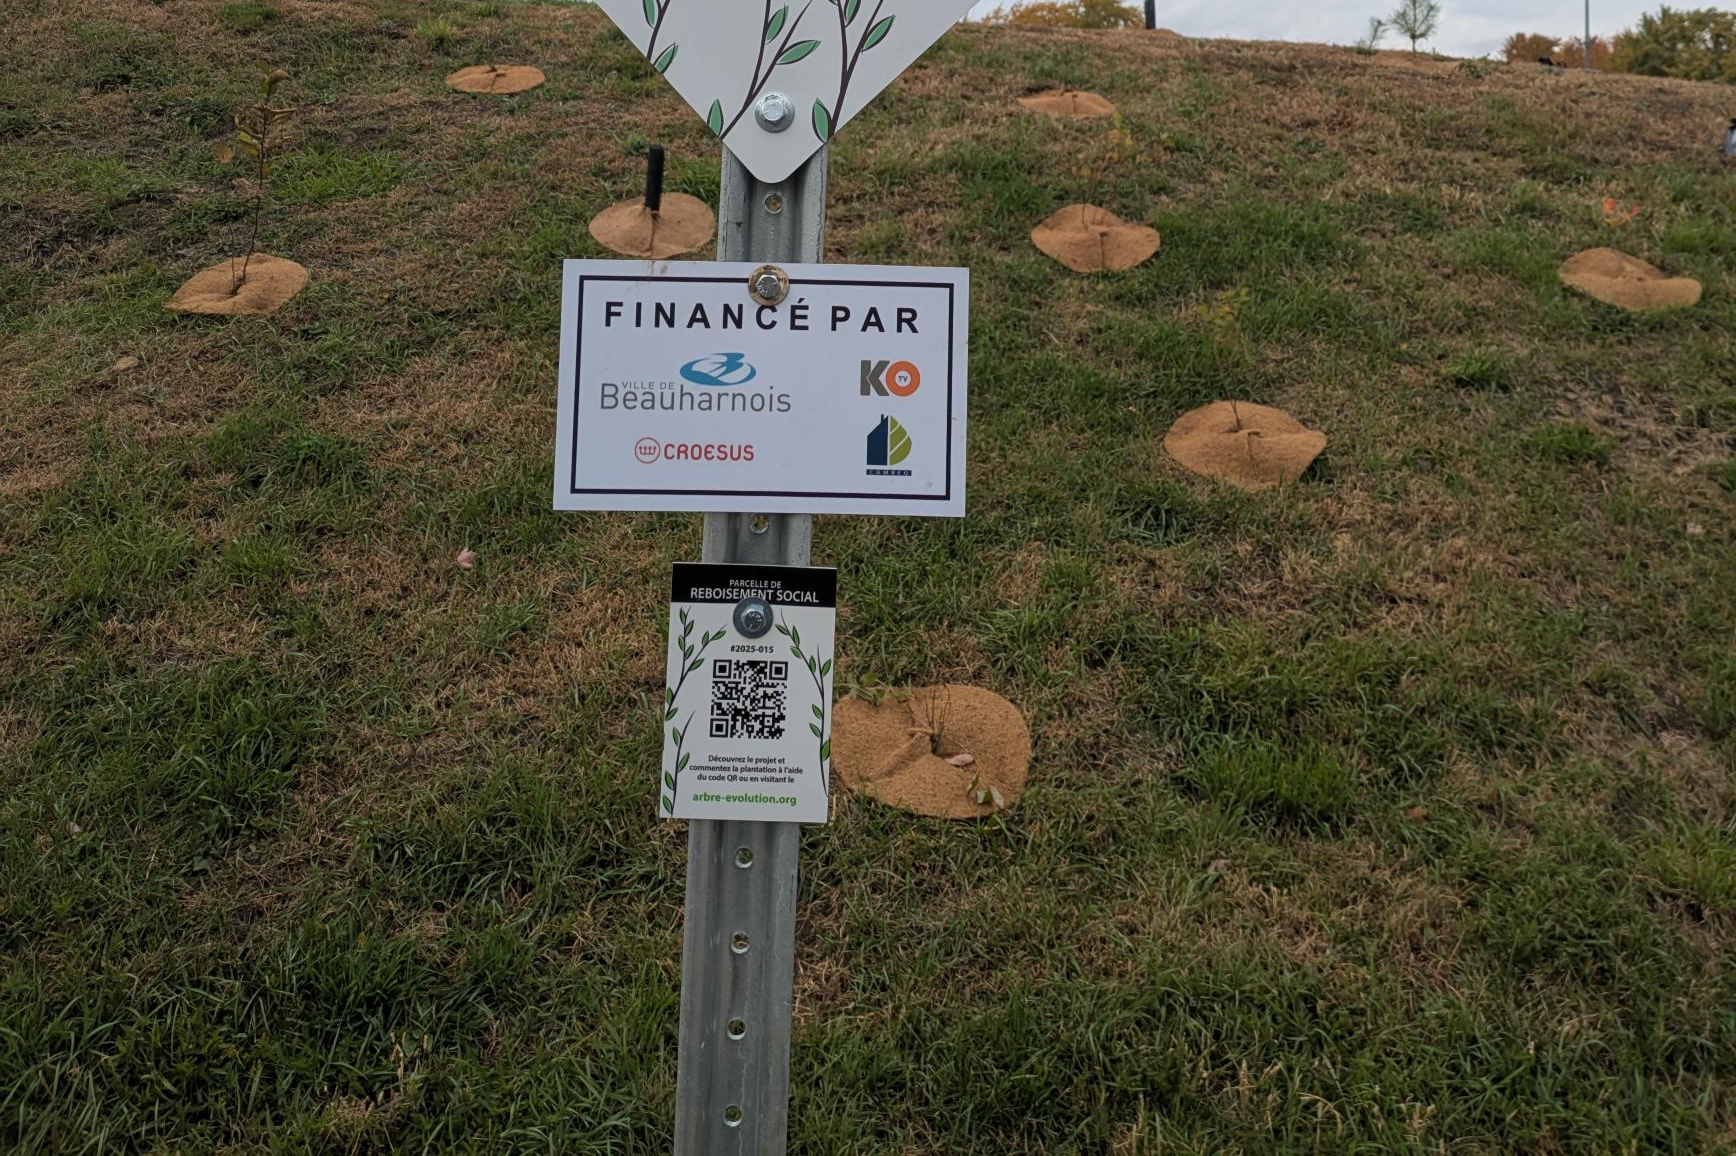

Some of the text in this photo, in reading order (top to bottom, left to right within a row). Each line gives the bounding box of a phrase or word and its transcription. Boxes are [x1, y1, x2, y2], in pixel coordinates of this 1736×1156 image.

[605, 297, 919, 334] FINANCÉ PAR
[860, 360, 921, 397] KO
[621, 381, 675, 390] VILLE DE
[600, 382, 792, 413] Beauharnois
[663, 443, 755, 462] CROESUS
[729, 579, 782, 589] PARCELLE DE
[690, 587, 820, 603] REBOISEMENT SOCIAL
[730, 644, 774, 654] #2025-015
[708, 754, 746, 763] Découvrez
[747, 755, 754, 763] le
[755, 756, 777, 765] projet
[732, 764, 739, 772] la
[740, 765, 777, 774] plantation
[697, 773, 707, 781] du
[727, 774, 738, 782] QR
[760, 775, 787, 783] visitant
[788, 776, 795, 784] le
[692, 792, 797, 807] arbre-evolution.org
